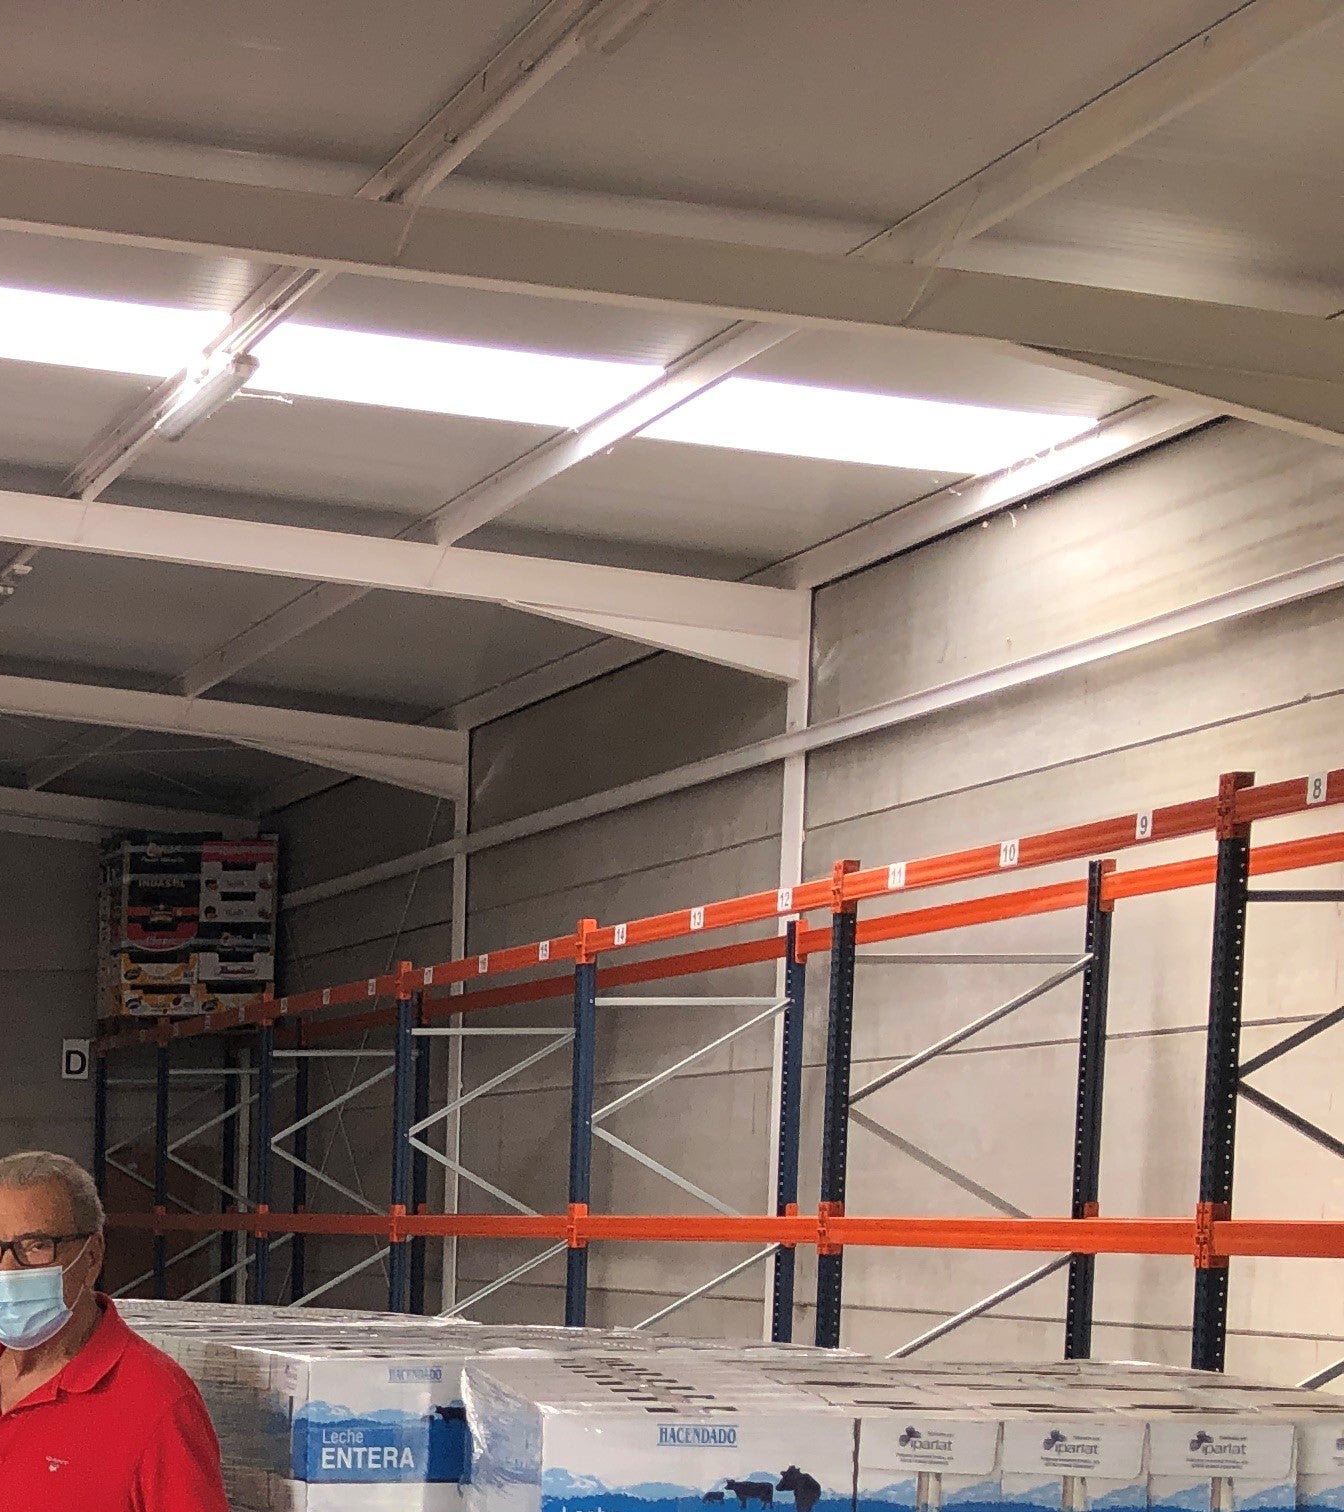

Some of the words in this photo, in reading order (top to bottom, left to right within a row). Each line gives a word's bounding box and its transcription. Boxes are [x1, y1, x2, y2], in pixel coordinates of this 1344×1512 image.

[1313, 778, 1322, 799] 8
[1139, 815, 1148, 836] 9
[1001, 843, 1017, 863] 10
[890, 867, 904, 885] 11
[779, 891, 790, 907] 12
[692, 910, 702, 926] 13
[615, 927, 625, 942] 14
[66, 1050, 86, 1076] D
[389, 1367, 442, 1383] HACENDADO
[322, 1429, 363, 1444] Leche
[658, 1425, 737, 1447] HACENDADO
[910, 1437, 953, 1452] iparlat
[1054, 1441, 1098, 1456] iparlat
[1202, 1442, 1247, 1456] iparlat
[321, 1448, 414, 1469] ENTERA
